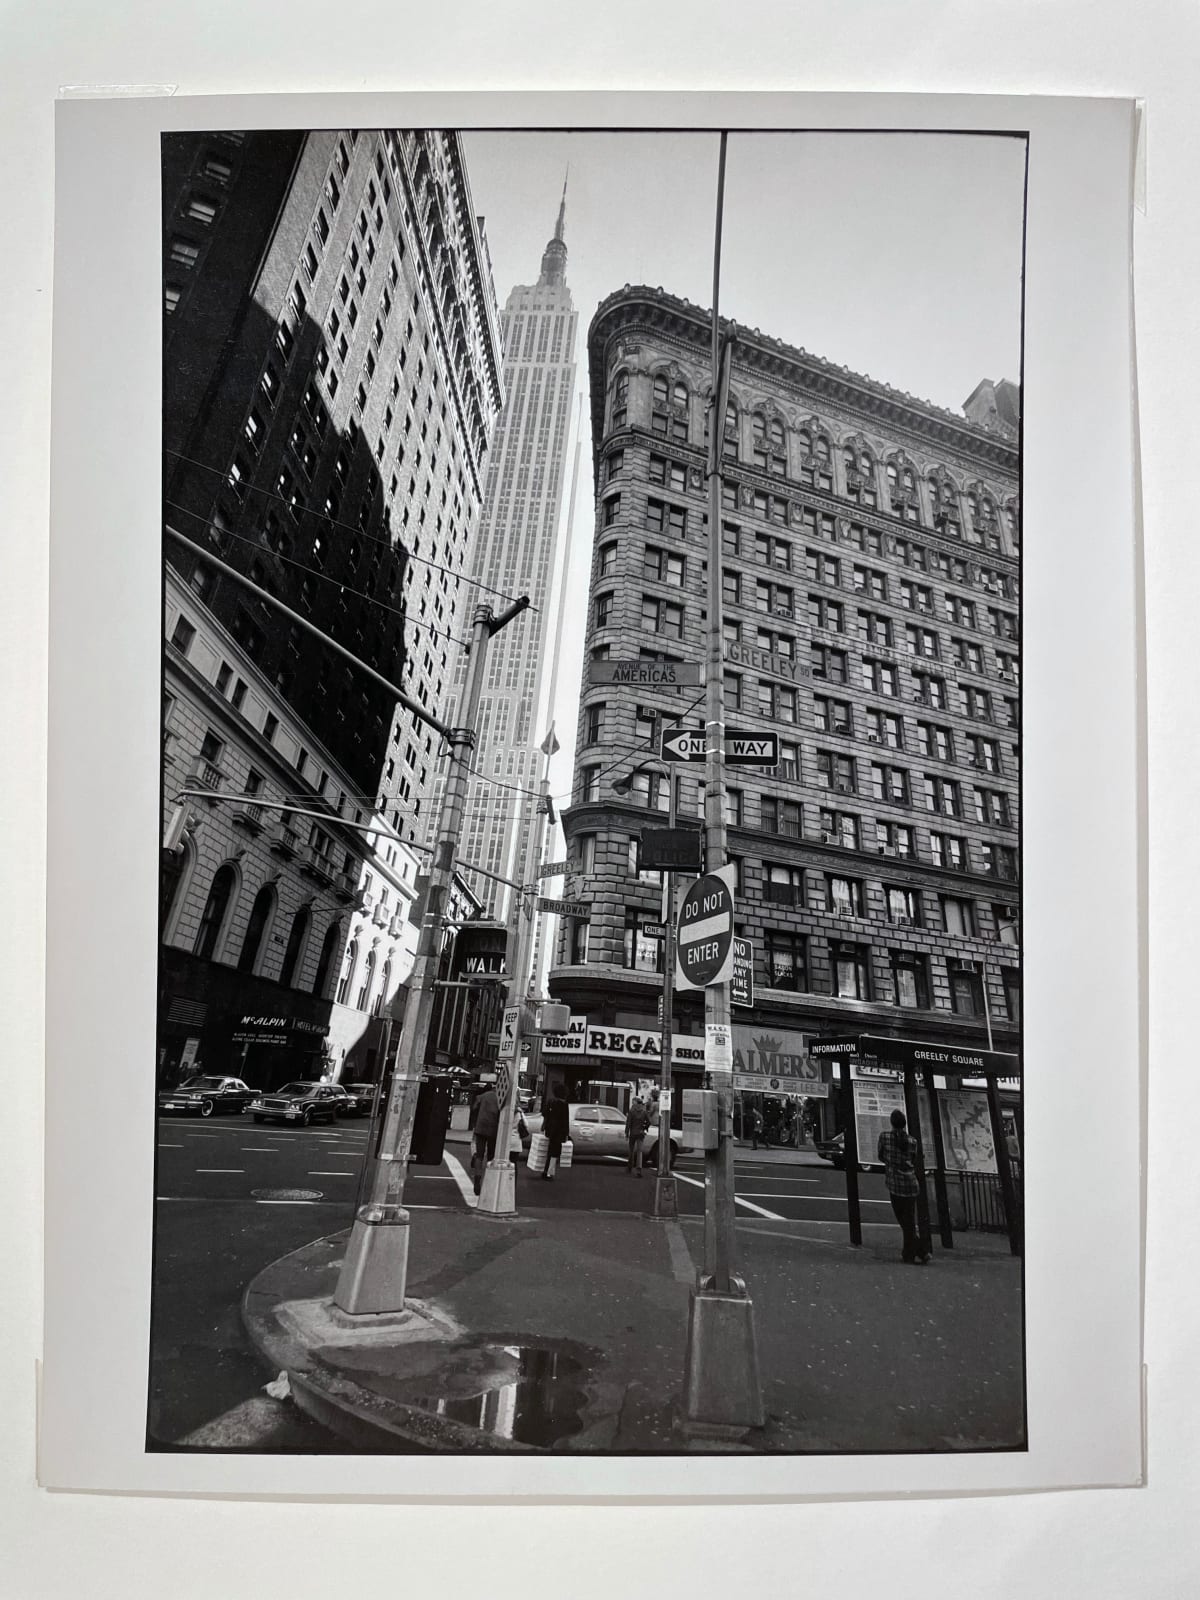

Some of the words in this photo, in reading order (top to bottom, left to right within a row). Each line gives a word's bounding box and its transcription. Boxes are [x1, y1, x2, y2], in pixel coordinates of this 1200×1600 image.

[730, 644, 796, 680] GREELEY
[612, 670, 676, 683] AMERICAS
[733, 742, 768, 755] WAY
[542, 862, 574, 876] GREELEY
[543, 901, 588, 916] BROADWAY
[685, 901, 698, 919] DO
[703, 891, 724, 913] NOT
[646, 926, 660, 935] ONE
[687, 941, 719, 965] ENTER
[734, 942, 746, 956] NO
[466, 957, 506, 973] WALK
[734, 957, 752, 969] ANDING
[734, 968, 747, 978] ANY
[733, 977, 748, 989] TIME
[505, 1012, 517, 1023] KEEP
[501, 1041, 514, 1051] LEFT
[545, 1037, 581, 1048] SHOES
[588, 1031, 663, 1055] REGA
[812, 1043, 856, 1054] INFORMATION
[733, 1049, 818, 1079] ALMER'S
[914, 1050, 948, 1062] GREELEY
[952, 1055, 984, 1067] SQUARE
